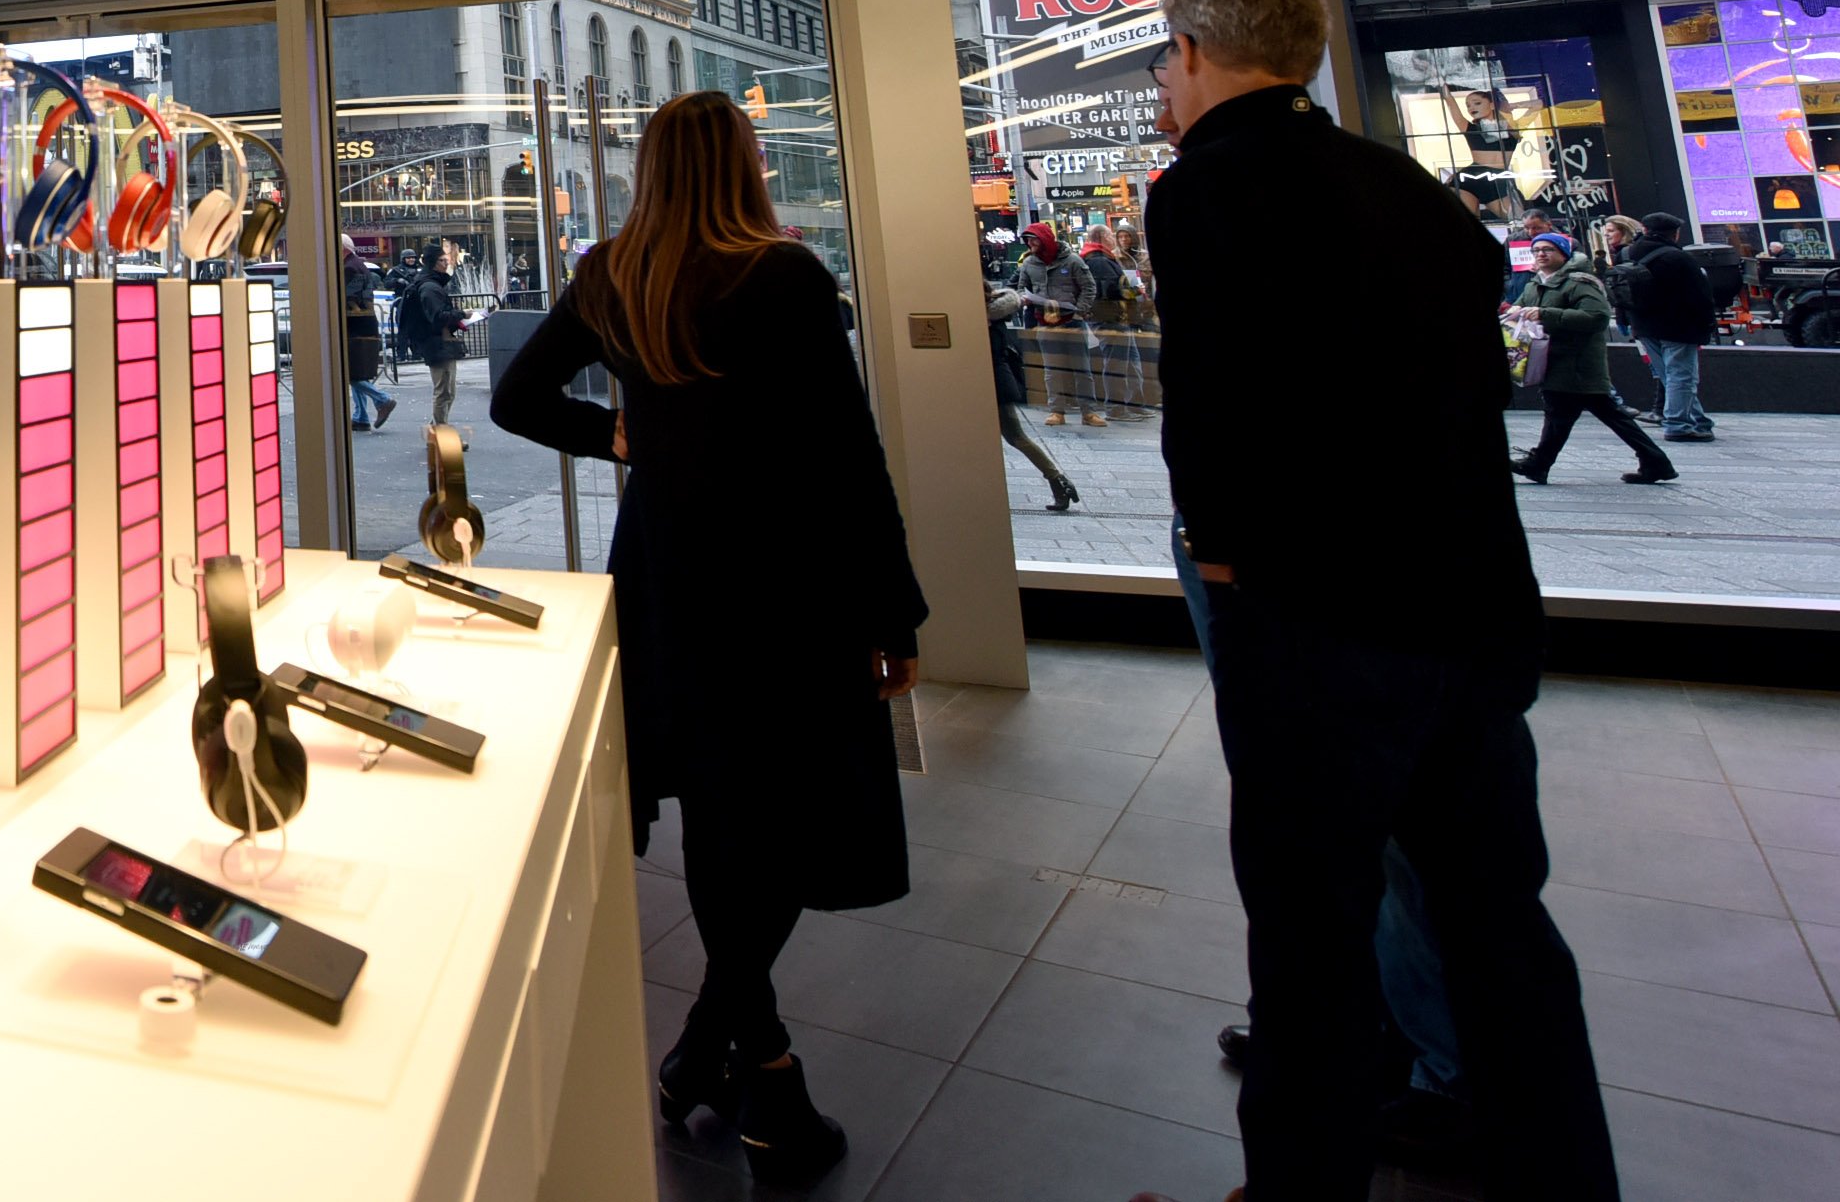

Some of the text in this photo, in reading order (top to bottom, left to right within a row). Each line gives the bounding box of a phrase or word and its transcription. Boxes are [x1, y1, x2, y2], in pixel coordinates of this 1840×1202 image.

[1060, 26, 1093, 45] THE
[1106, 126, 1116, 137] &
[1042, 151, 1125, 175] GIFTS
[1061, 186, 1114, 197] Apple Nik
